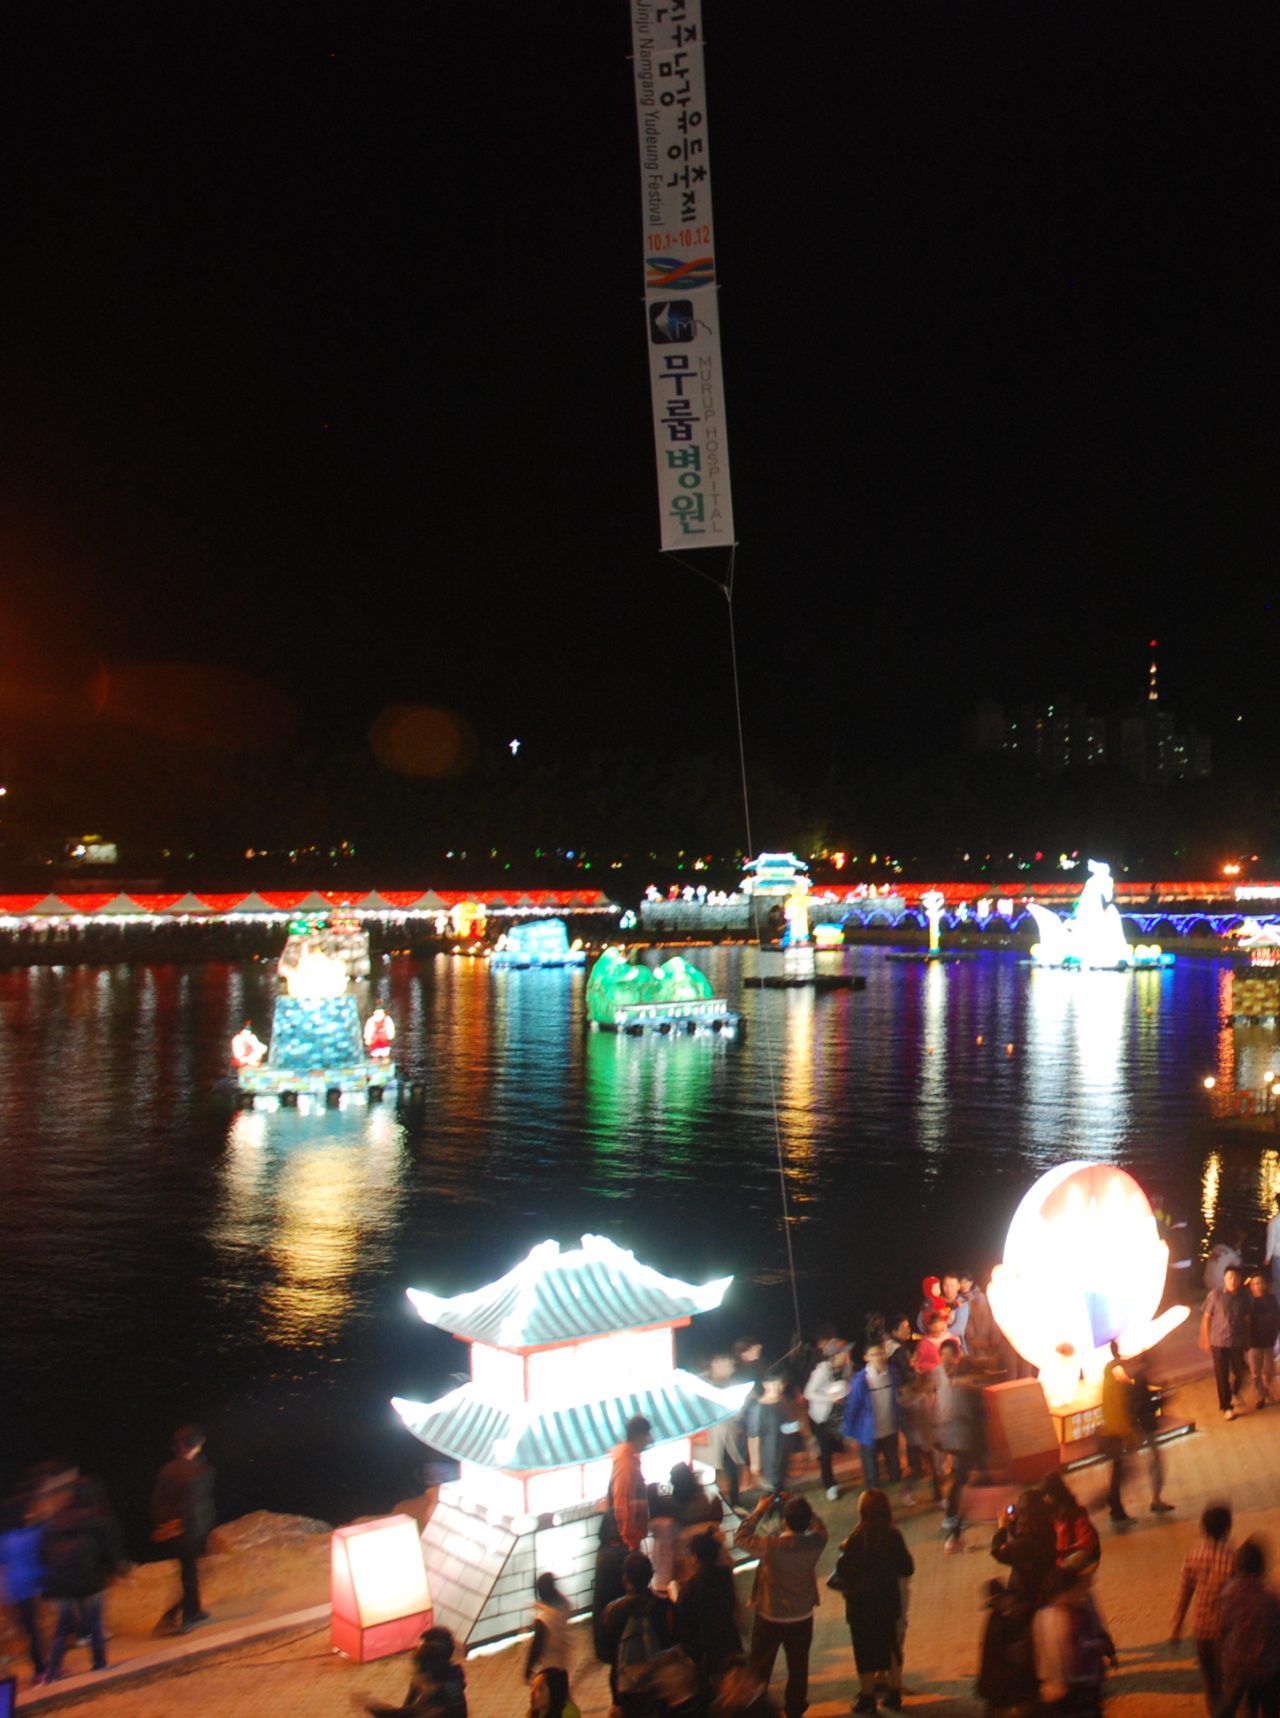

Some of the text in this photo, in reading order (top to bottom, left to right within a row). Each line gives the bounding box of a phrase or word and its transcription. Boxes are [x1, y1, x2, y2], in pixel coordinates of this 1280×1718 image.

[635, 0, 664, 227] Jinju Namgang Yudeung Festival
[706, 427, 723, 533] HOSPITAL
